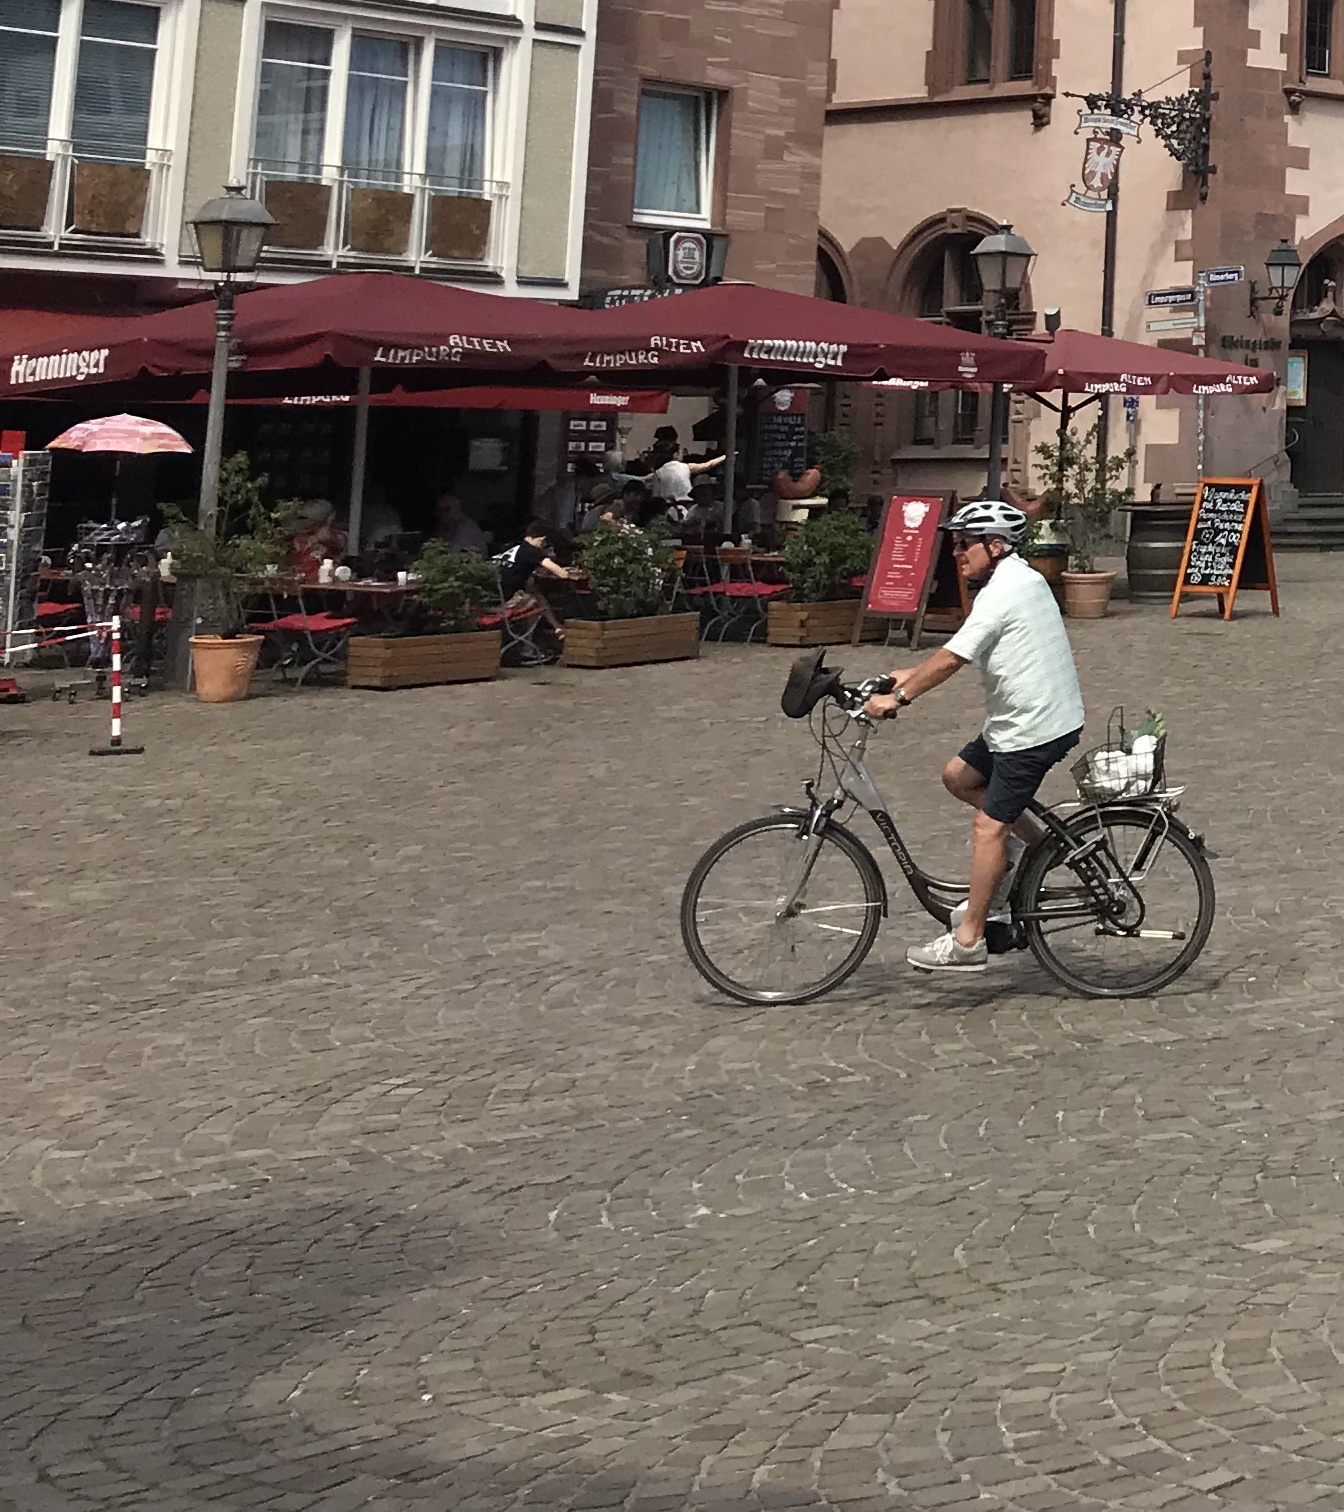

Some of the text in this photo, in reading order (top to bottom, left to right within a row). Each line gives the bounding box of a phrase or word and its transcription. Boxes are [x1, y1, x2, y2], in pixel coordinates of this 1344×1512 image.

[449, 334, 512, 353] ALTEN
[650, 336, 705, 353] ALTEN
[374, 346, 463, 364] LIMPURG
[584, 351, 658, 367] LIMPURG
[743, 339, 848, 369] Henninger
[10, 348, 109, 385] Henninger
[1084, 382, 1127, 393] LIMPURG
[1120, 374, 1152, 386] ALTEN
[1226, 374, 1258, 385] ALTEN
[1193, 383, 1233, 394] LIMPURG
[876, 812, 914, 876] VICTORIA
